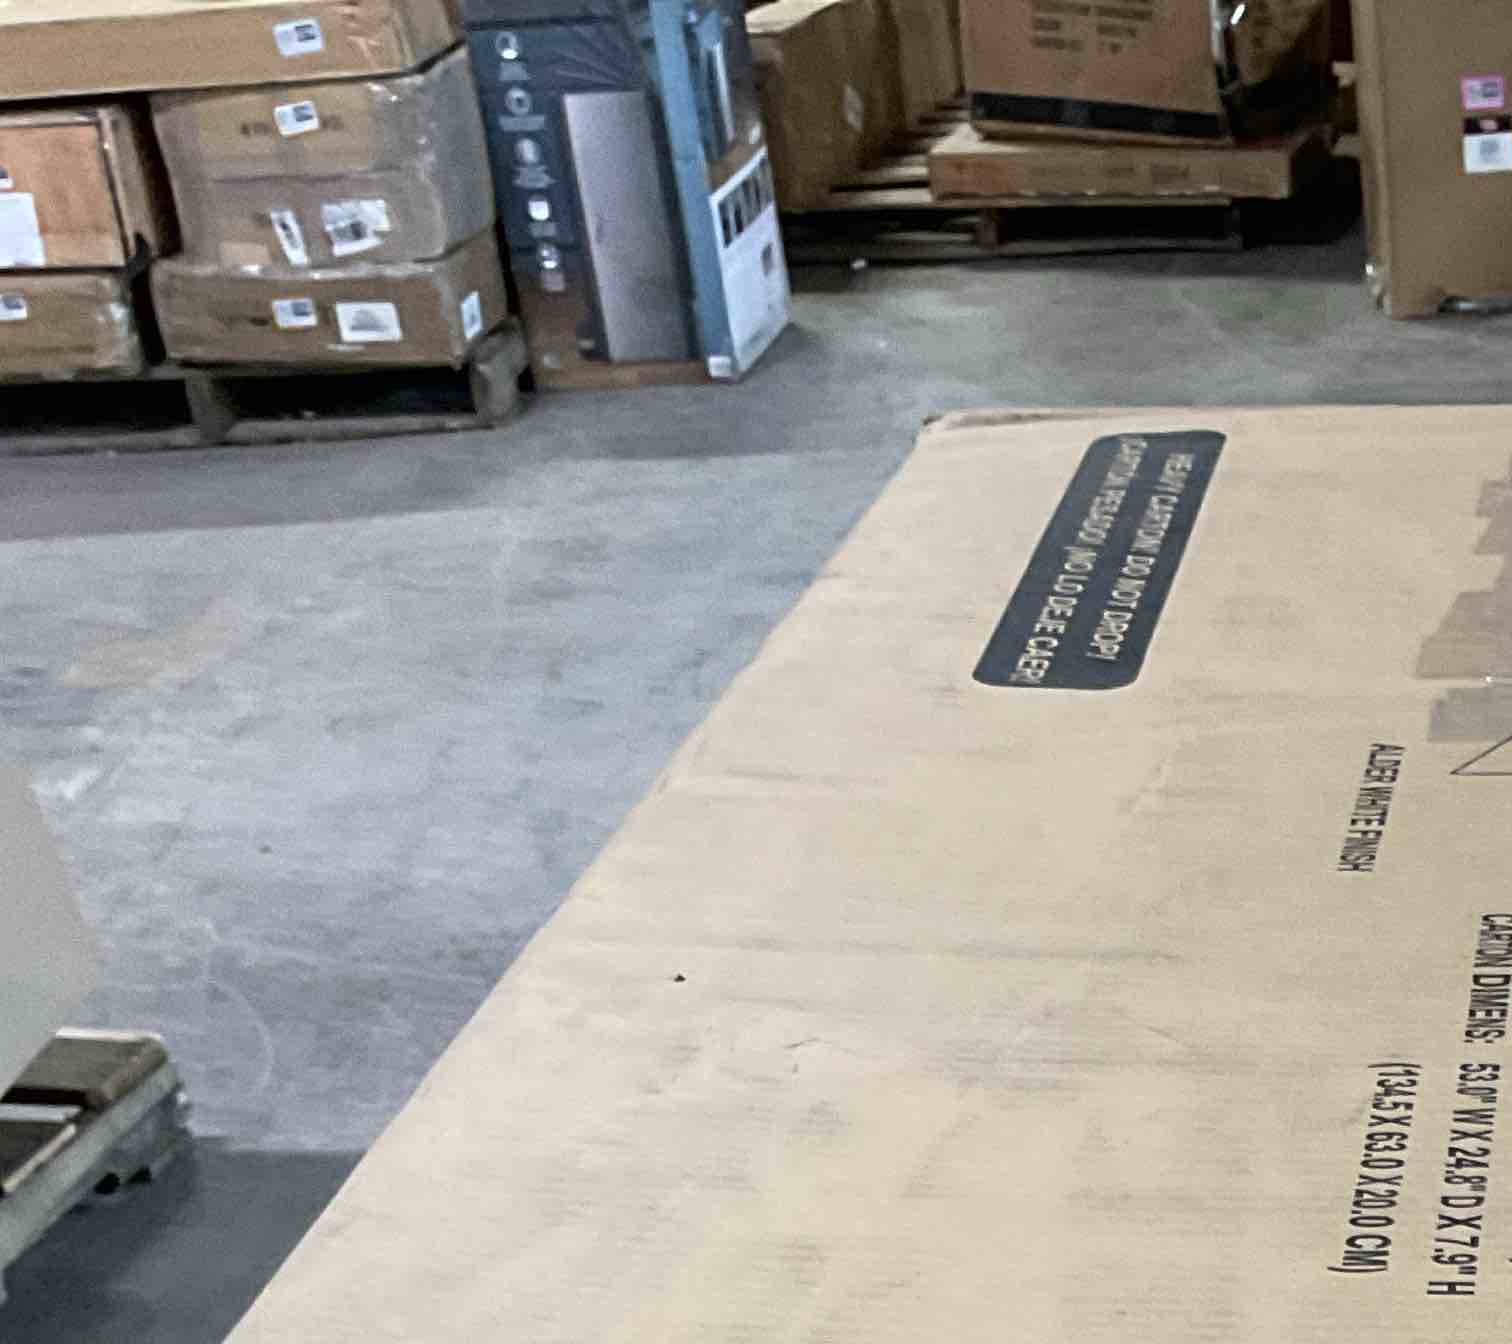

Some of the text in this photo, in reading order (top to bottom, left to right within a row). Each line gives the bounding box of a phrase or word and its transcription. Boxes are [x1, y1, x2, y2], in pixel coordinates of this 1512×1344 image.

[1121, 554, 1155, 575] DO
[1053, 574, 1089, 593] LO
[1107, 576, 1147, 609] NOT
[1034, 596, 1077, 634] DEJE
[1086, 609, 1134, 660] DROP!
[1336, 743, 1406, 872] ALDER WHITE FINISH
[1463, 974, 1512, 1044] DIMENS:
[1453, 1107, 1497, 1125] W
[1450, 1129, 1494, 1142] X
[1326, 1062, 1422, 1273] (134.5 X 63.0 X 20.0 CM)
[1440, 1195, 1485, 1208] D
[1437, 1215, 1483, 1230] X
[1426, 1281, 1476, 1296] H
